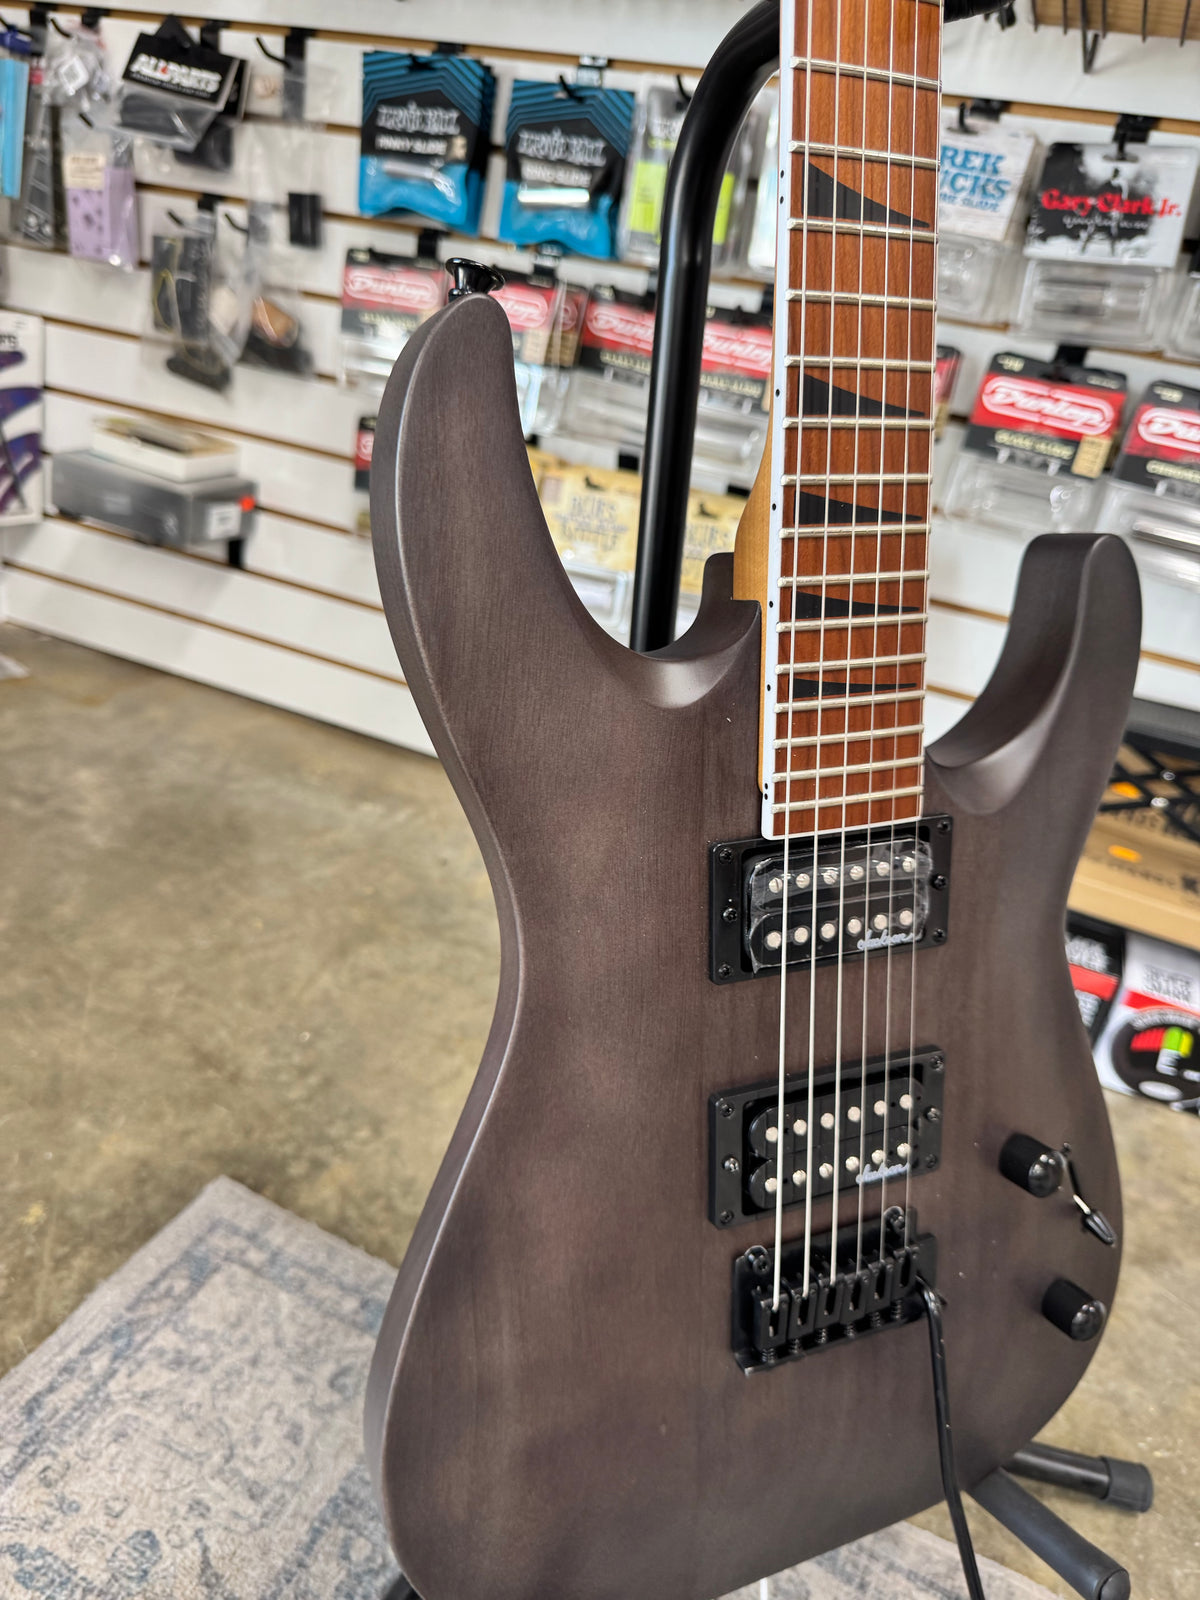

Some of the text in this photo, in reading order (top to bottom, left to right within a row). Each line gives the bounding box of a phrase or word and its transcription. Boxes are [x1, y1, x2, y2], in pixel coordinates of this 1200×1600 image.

[940, 145, 1006, 176] REK
[1041, 188, 1183, 219] Gary Clark Jr.
[991, 386, 1107, 427] Dunlop
